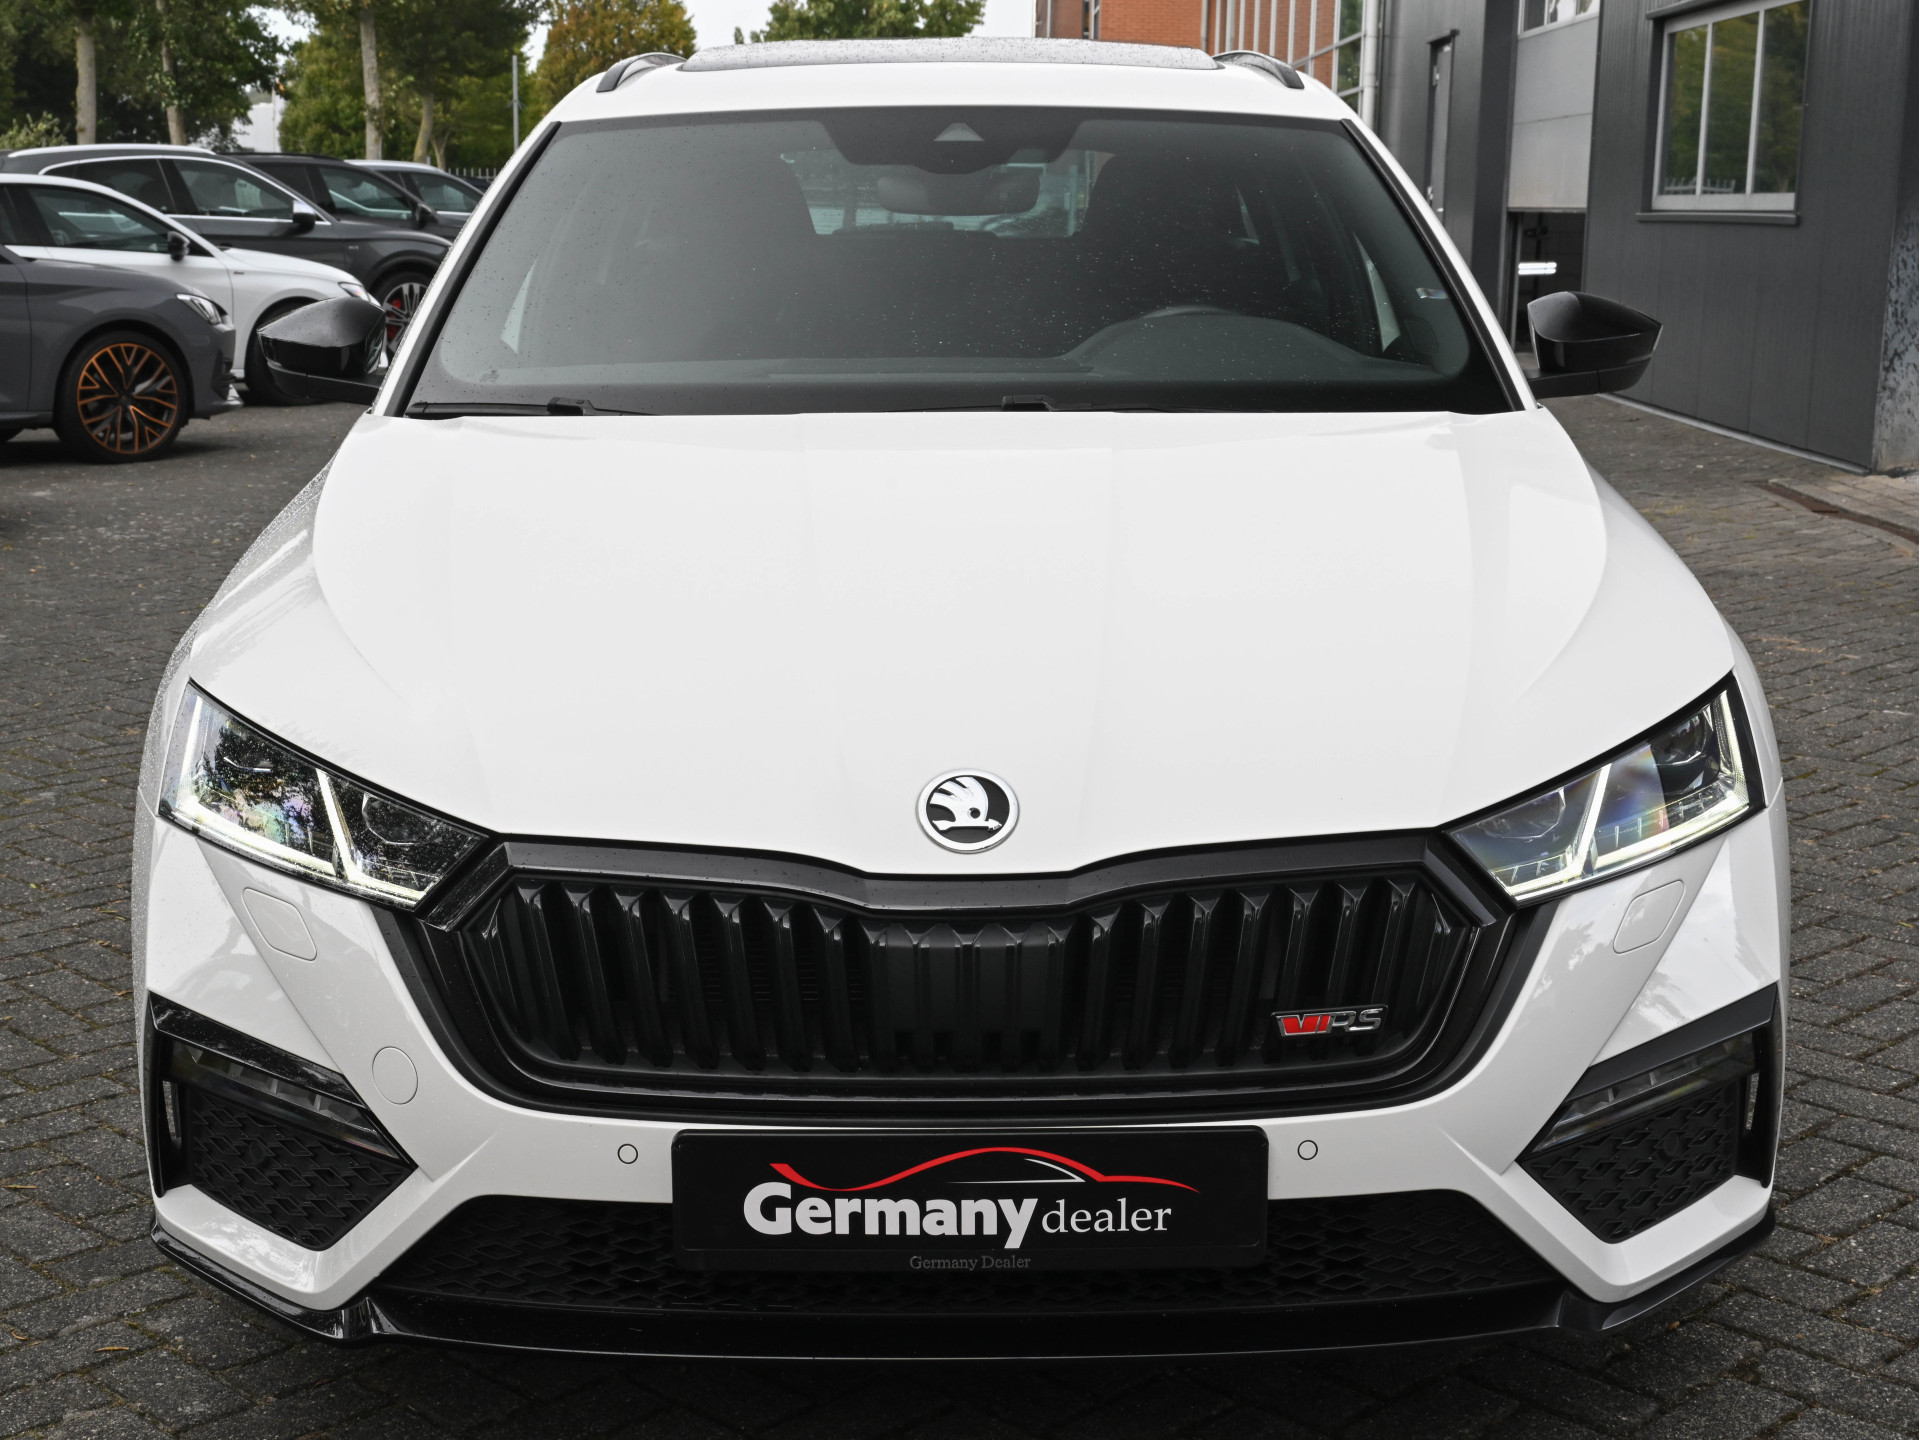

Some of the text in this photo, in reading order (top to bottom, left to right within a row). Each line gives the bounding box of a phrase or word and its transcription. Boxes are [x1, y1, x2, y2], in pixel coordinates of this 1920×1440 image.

[743, 1181, 1172, 1249] Germany dealer
[909, 1254, 1032, 1271] Germany Dealer
